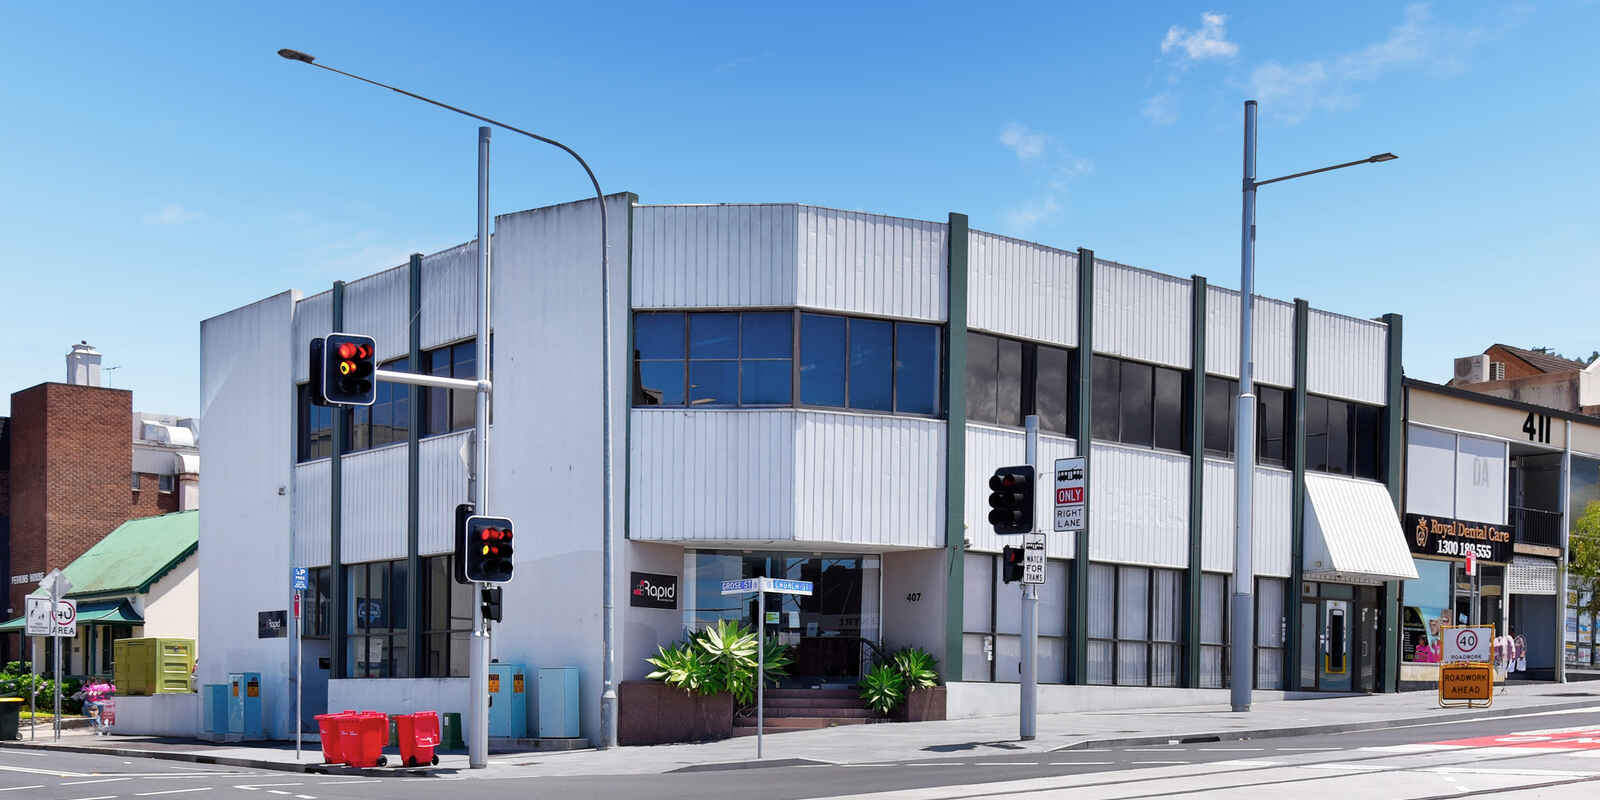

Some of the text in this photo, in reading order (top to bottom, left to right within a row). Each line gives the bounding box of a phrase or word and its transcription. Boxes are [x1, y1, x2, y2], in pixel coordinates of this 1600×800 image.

[1523, 411, 1552, 444] 411
[1059, 488, 1082, 502] ONLY
[1057, 509, 1082, 518] RIGHT
[1058, 519, 1081, 528] LANE
[1431, 519, 1510, 542] Royal Dental Care
[1437, 540, 1458, 554] 1300
[1477, 544, 1492, 559] 555
[1027, 555, 1043, 564] WATCH
[1026, 565, 1043, 573] FOR
[1026, 573, 1043, 582] TRAMS
[644, 580, 675, 600] Rapid
[721, 580, 752, 591] GROSE ST
[906, 592, 921, 602] 407
[52, 626, 74, 634] AREA
[1459, 636, 1475, 646] 40
[1452, 686, 1479, 695] AHEAD
